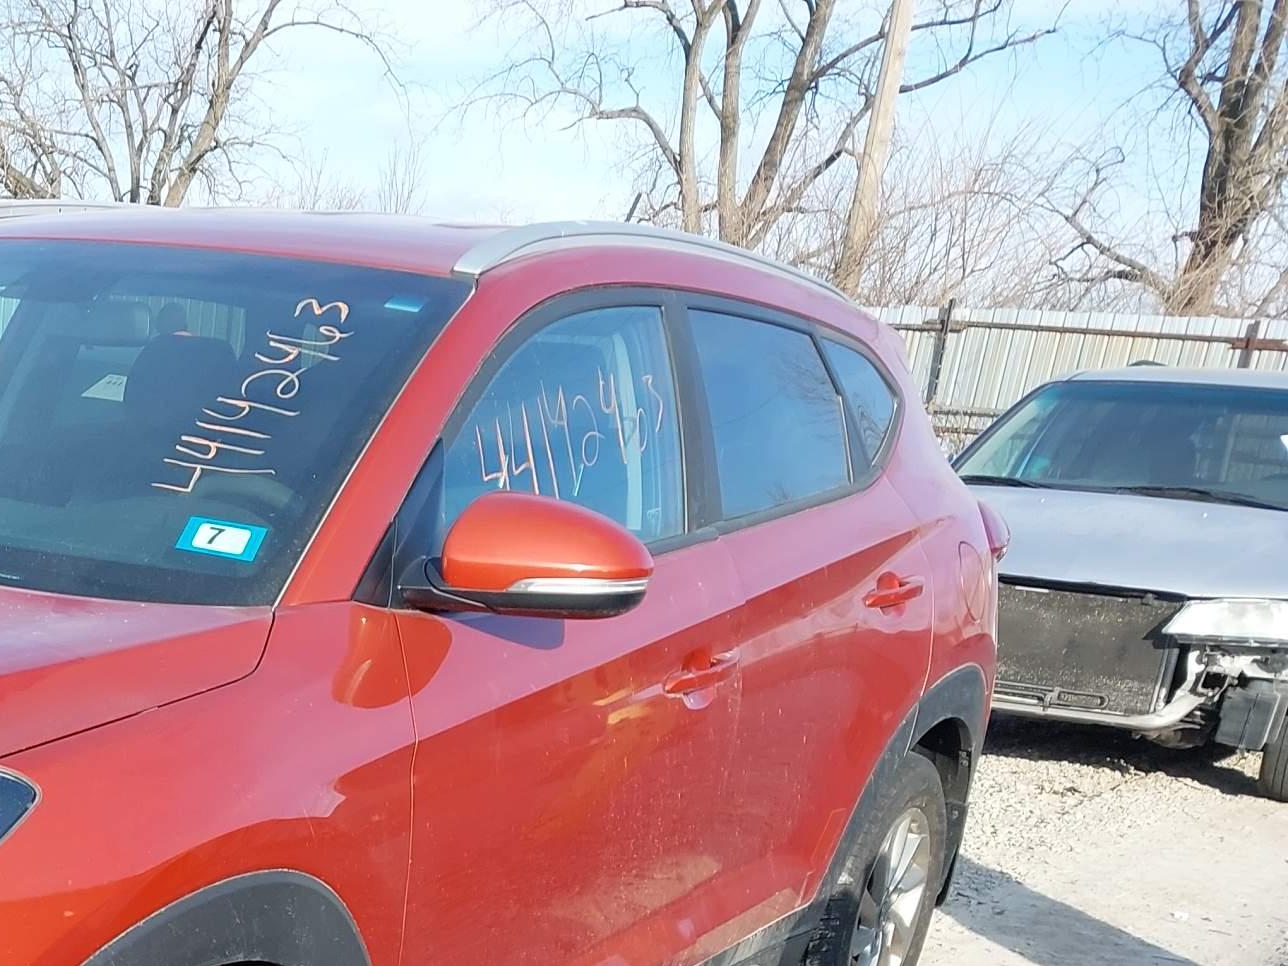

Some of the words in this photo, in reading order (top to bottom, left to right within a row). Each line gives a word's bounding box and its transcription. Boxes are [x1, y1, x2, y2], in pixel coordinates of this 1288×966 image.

[151, 298, 354, 492] 44142463
[475, 366, 663, 500] 44142463
[207, 526, 227, 545] 7
